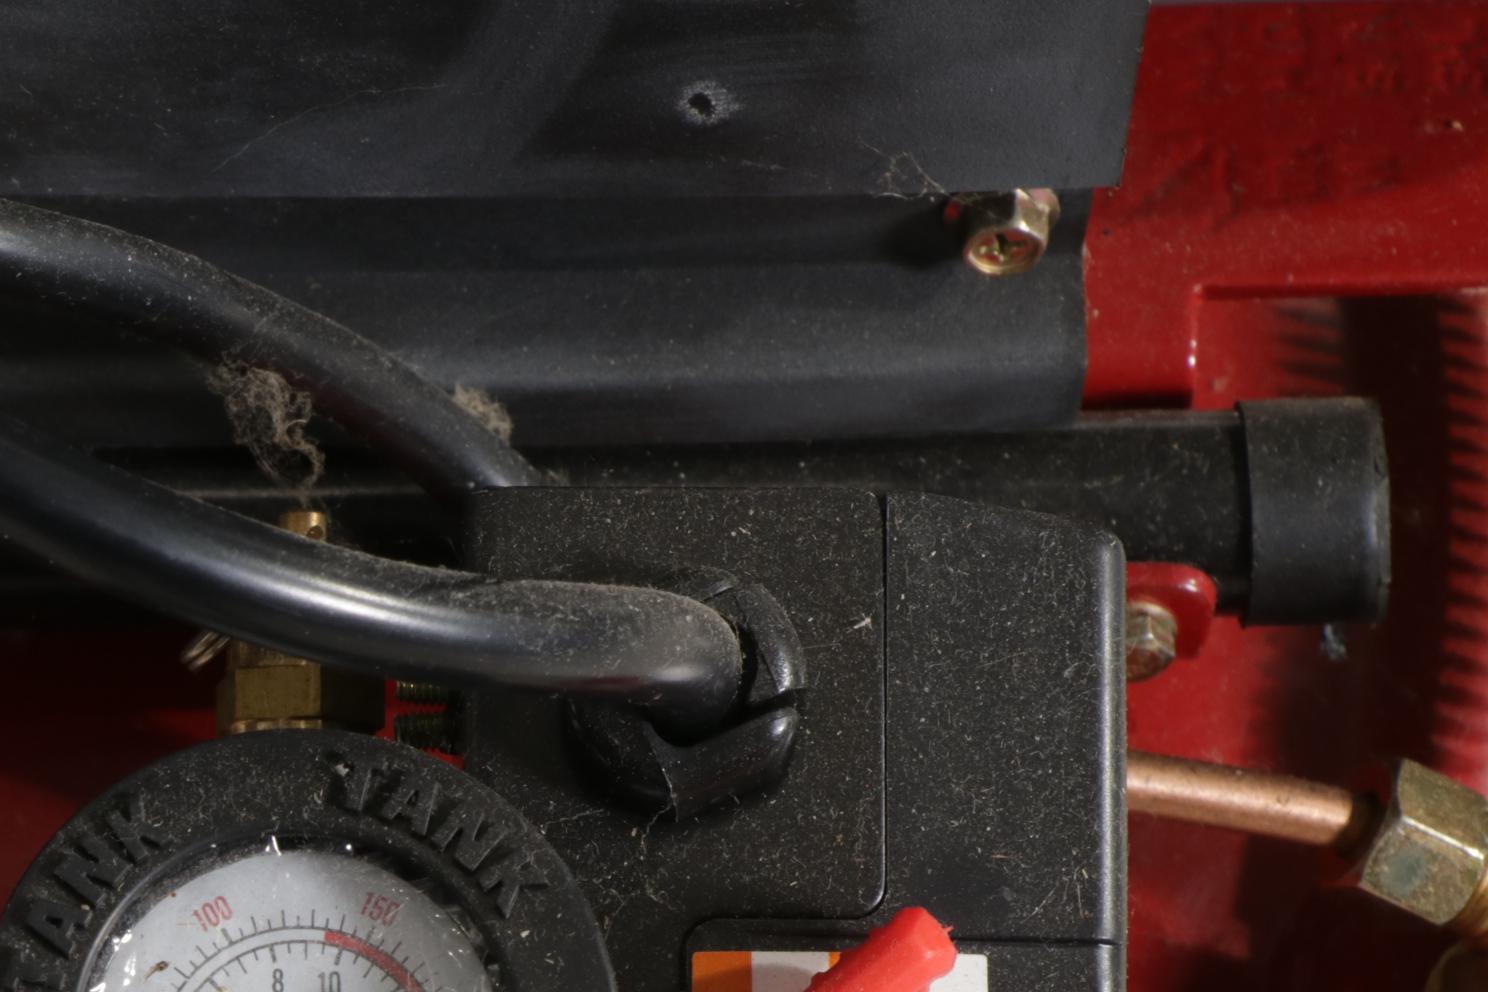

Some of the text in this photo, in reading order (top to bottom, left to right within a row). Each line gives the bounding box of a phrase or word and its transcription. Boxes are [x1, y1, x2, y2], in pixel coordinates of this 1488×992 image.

[328, 755, 550, 919] TANK
[192, 896, 234, 932] 100
[360, 891, 401, 928] 150
